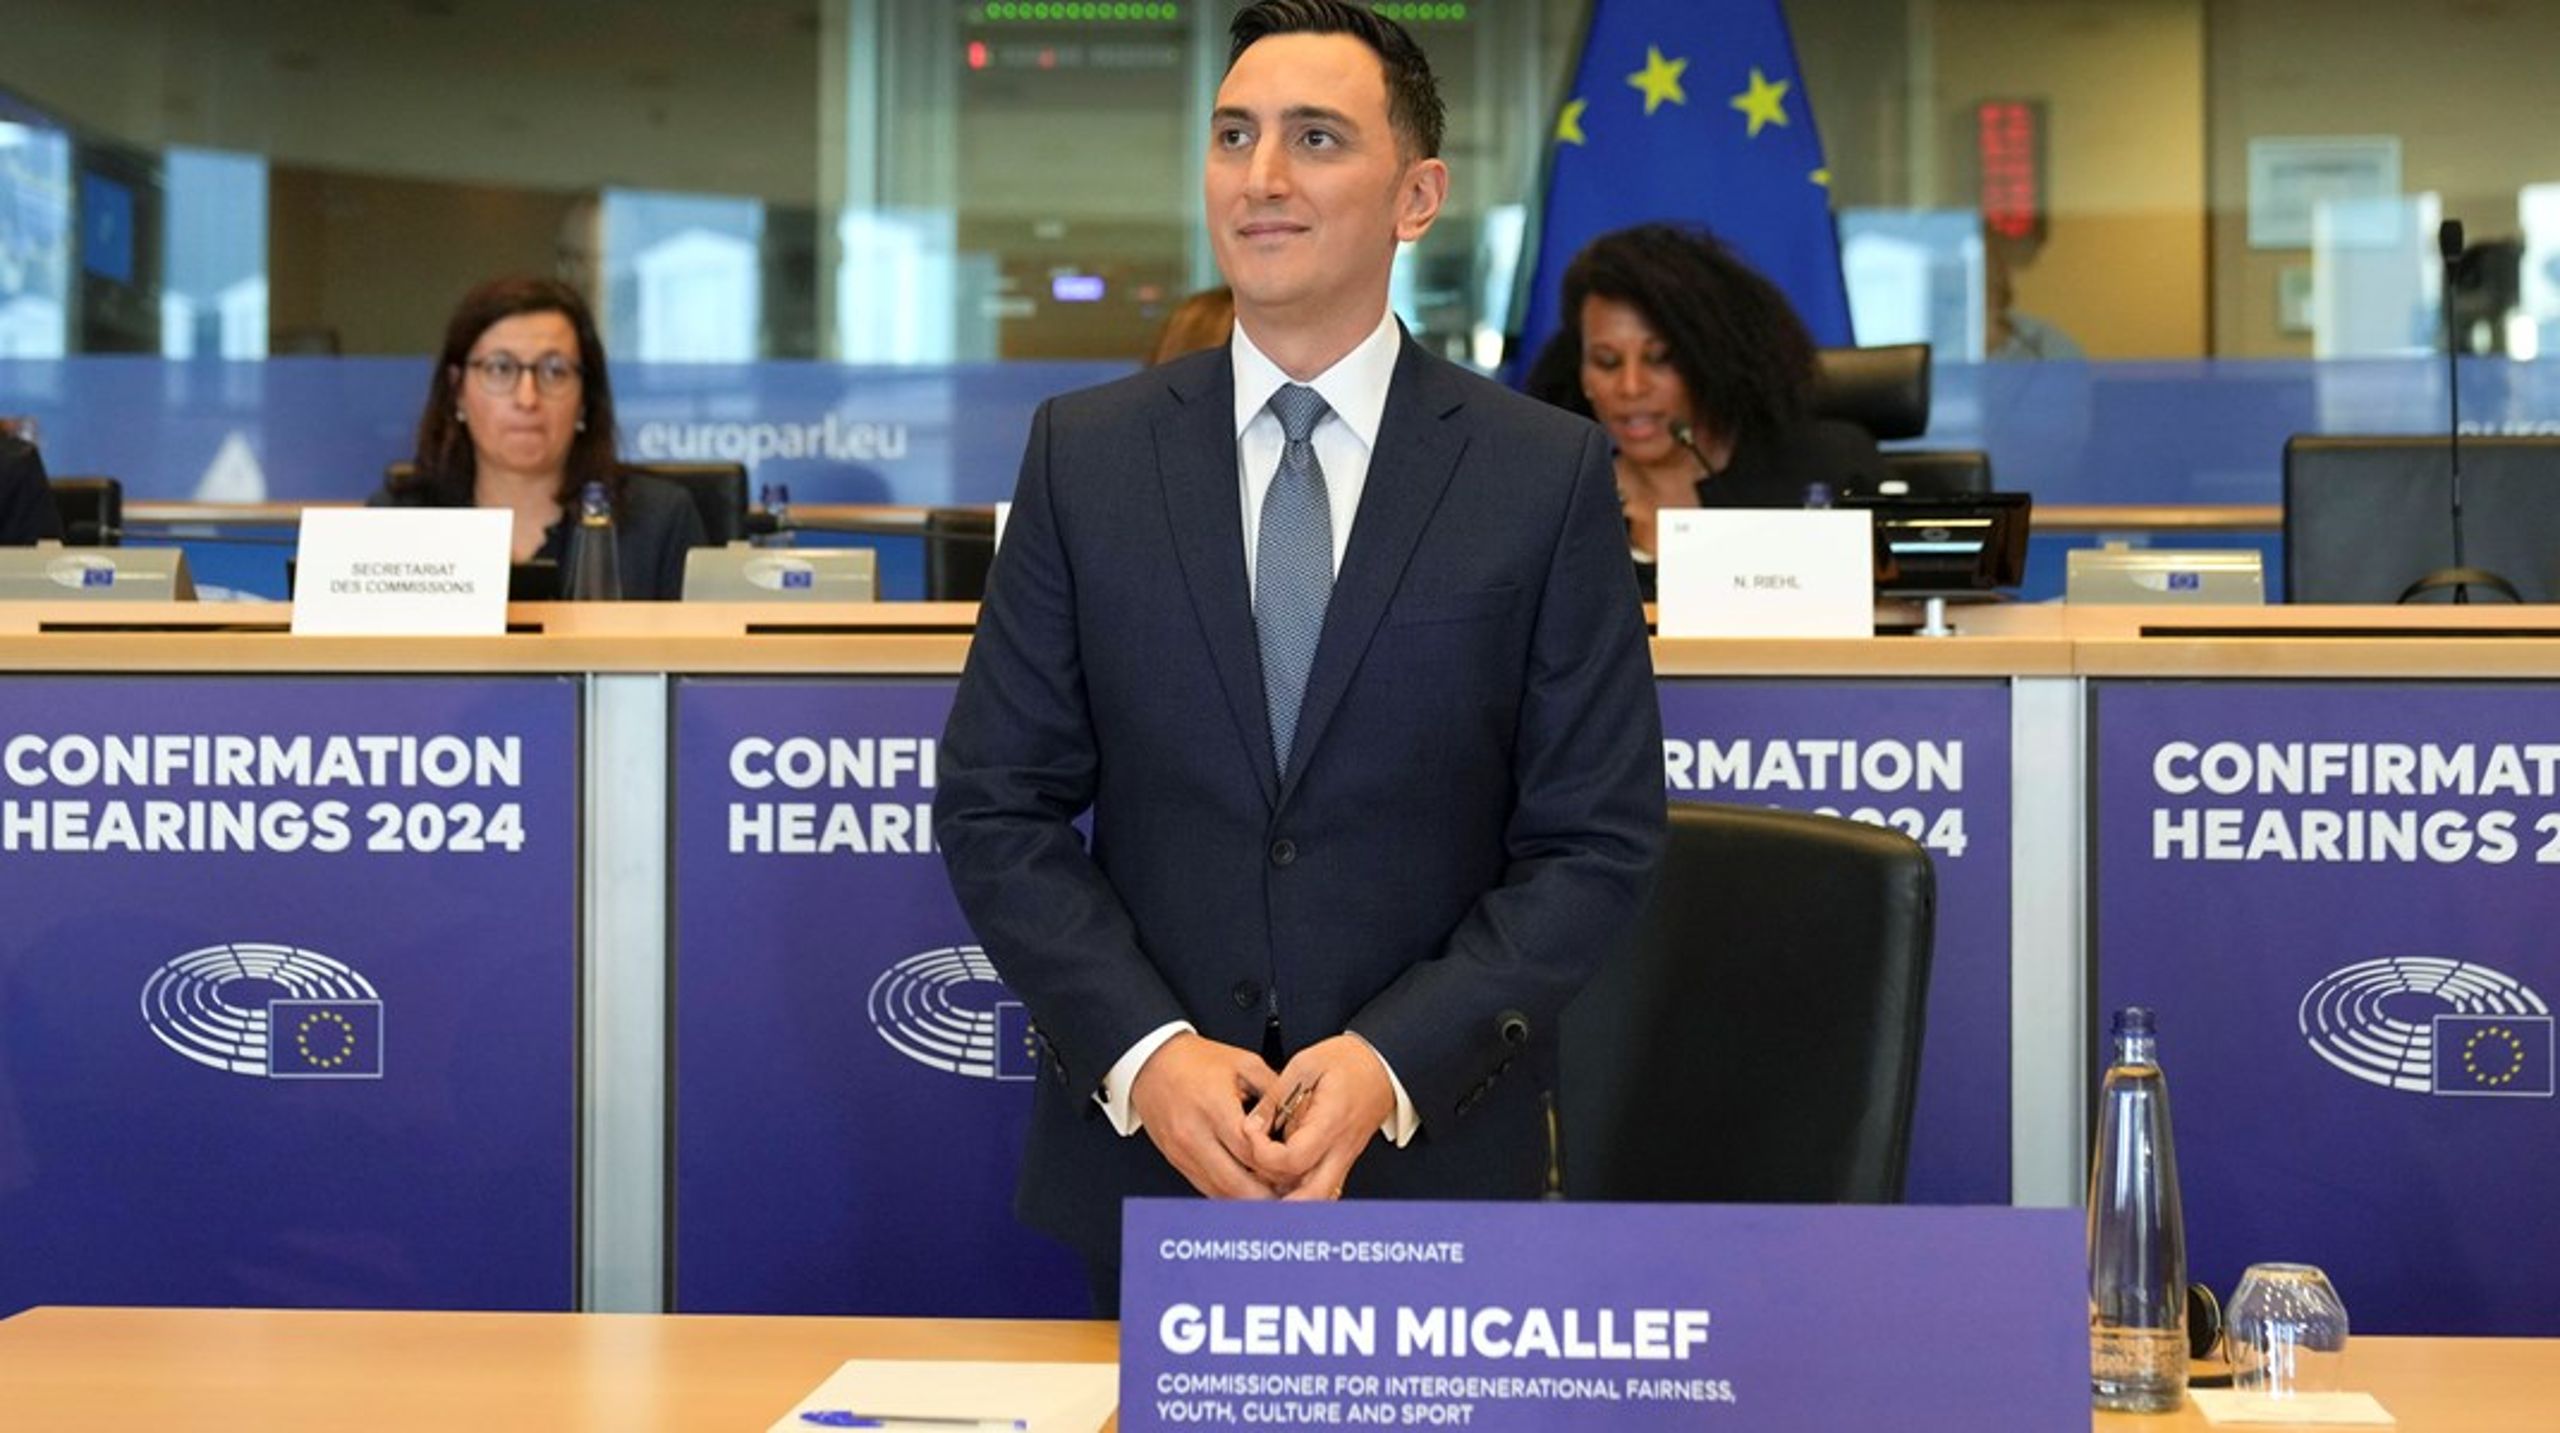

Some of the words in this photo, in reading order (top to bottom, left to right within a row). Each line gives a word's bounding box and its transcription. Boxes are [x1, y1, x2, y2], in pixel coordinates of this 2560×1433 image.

[638, 413, 907, 469] europarl.eu
[330, 580, 362, 594] DES
[365, 580, 475, 594] COMMISSIONS
[351, 562, 457, 577] SECRETARIAT
[1752, 575, 1801, 590] RIEHL
[4, 735, 521, 787] CONFIRMATION
[2154, 742, 2560, 795] CONFIRMAT
[4, 801, 352, 851] HEARINGS
[367, 803, 525, 852] 2024
[730, 804, 941, 853] HEARI
[2154, 809, 2519, 863] HEARINGS
[1160, 1239, 1465, 1264] COMMISSIONER-DESIGNATE
[1160, 1303, 1376, 1356] GLENN
[1397, 1307, 1710, 1360] MICALLEF
[1157, 1373, 1329, 1396] COMMISSIONER
[1335, 1375, 1380, 1397] FOR
[1385, 1376, 1621, 1400] INTERGENERATIONAL
[1627, 1379, 1736, 1404] FAIRNESS,
[1157, 1400, 1237, 1425] YOUTH,
[1242, 1401, 1341, 1423] CULTURE
[1347, 1403, 1397, 1425] AND
[1402, 1403, 1474, 1425] SPORT
